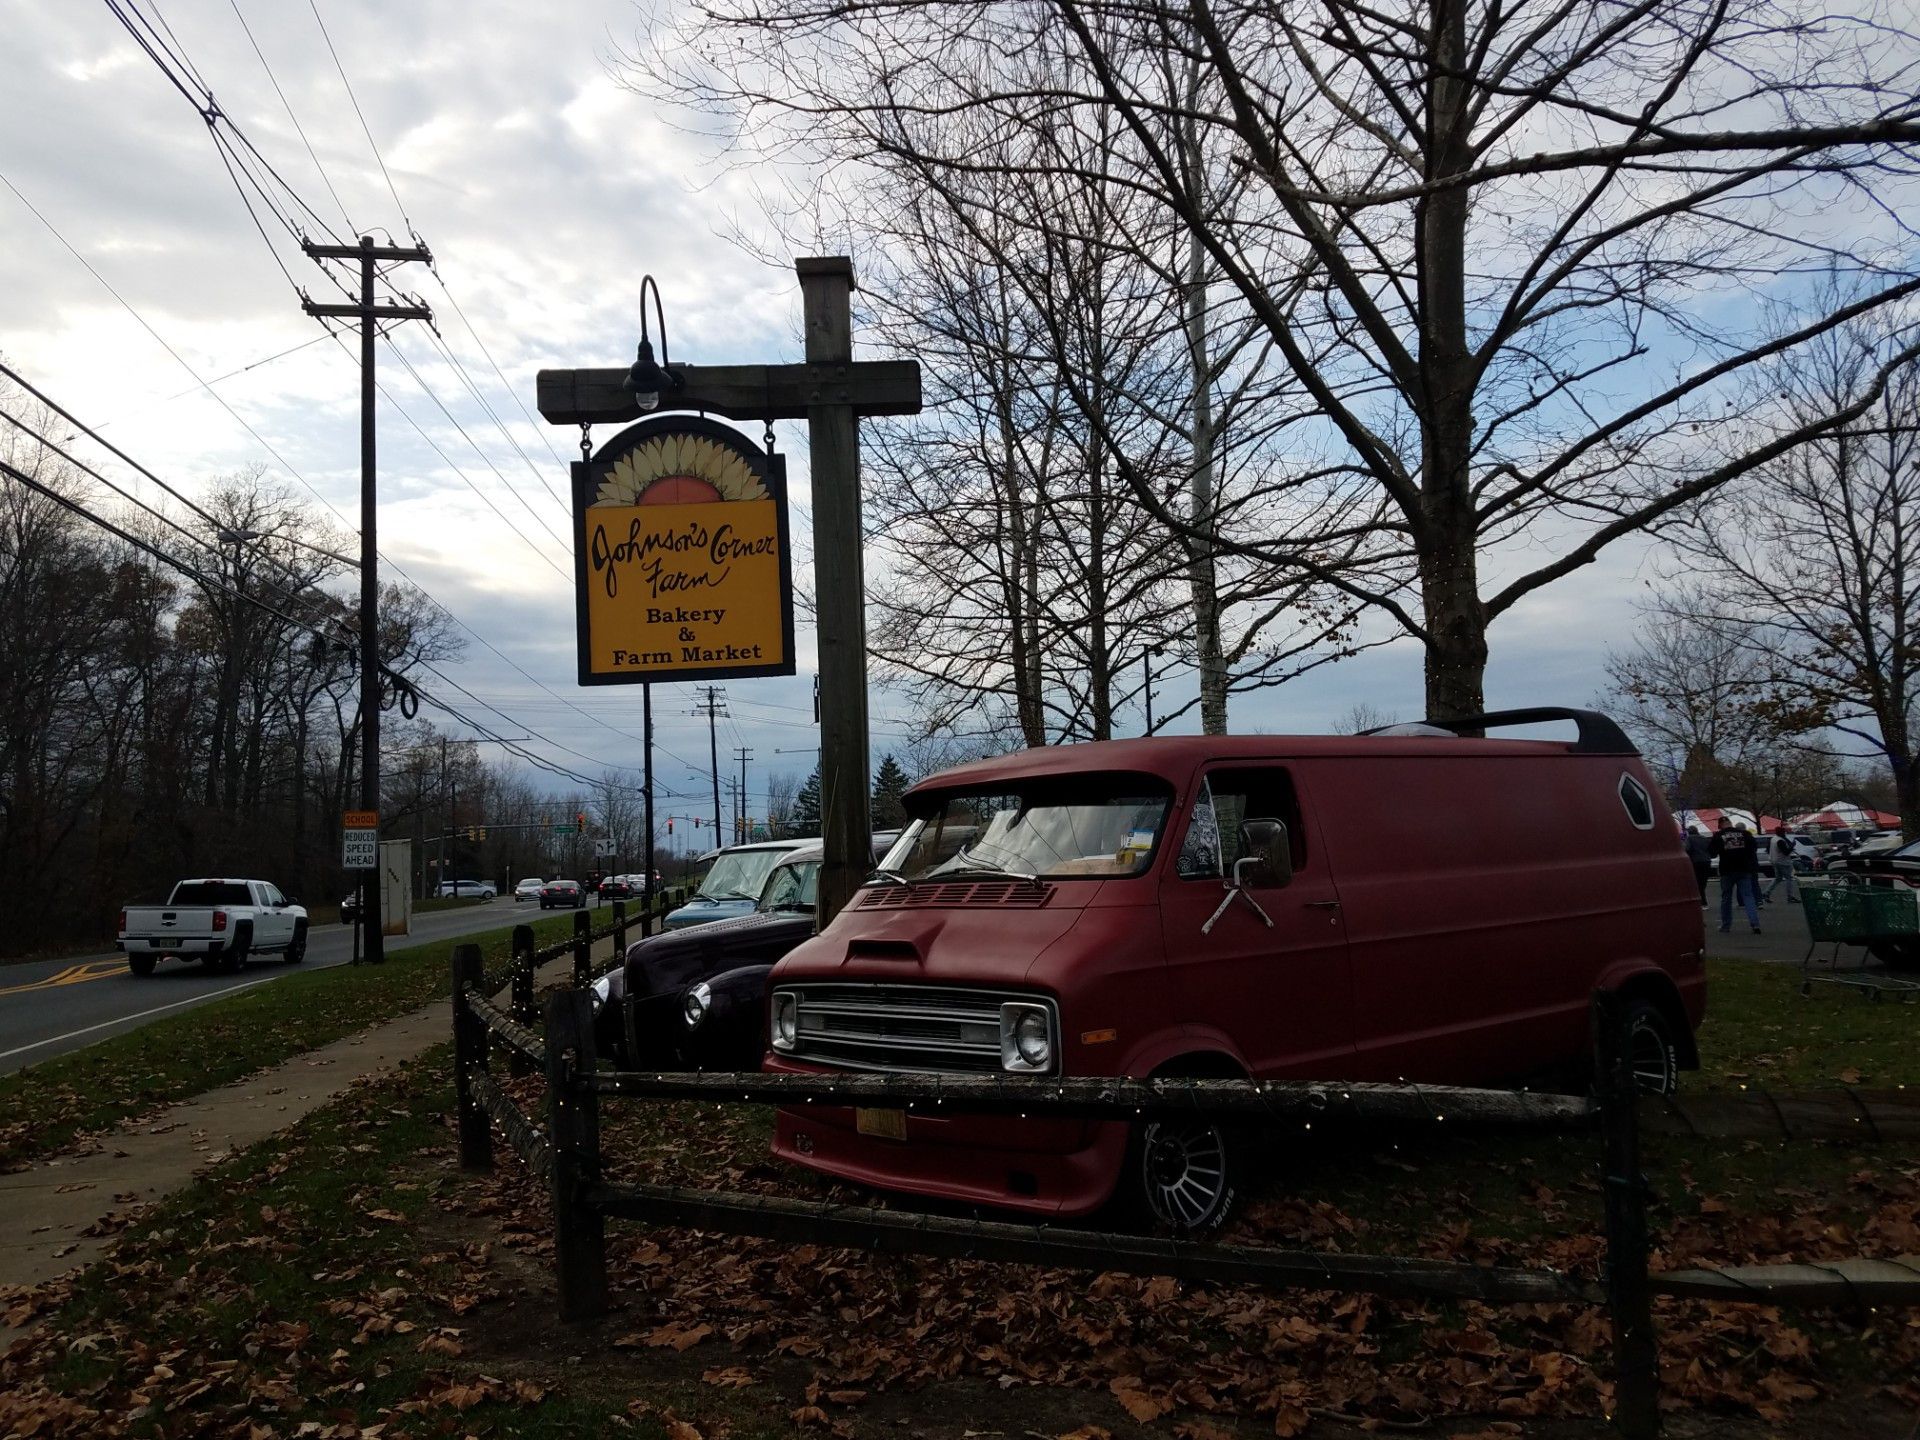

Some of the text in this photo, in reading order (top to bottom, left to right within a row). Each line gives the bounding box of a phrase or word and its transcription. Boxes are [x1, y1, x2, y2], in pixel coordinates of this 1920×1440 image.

[592, 517, 775, 598] Johnson's Corner
[641, 556, 731, 598] Farm
[646, 606, 726, 625] Bakery
[678, 626, 696, 642] &
[612, 643, 762, 666] Farm Market
[345, 815, 375, 824] SCHOOL
[345, 832, 375, 842] REDUCED
[346, 844, 374, 853] SPEED
[345, 855, 374, 865] AHEAD
